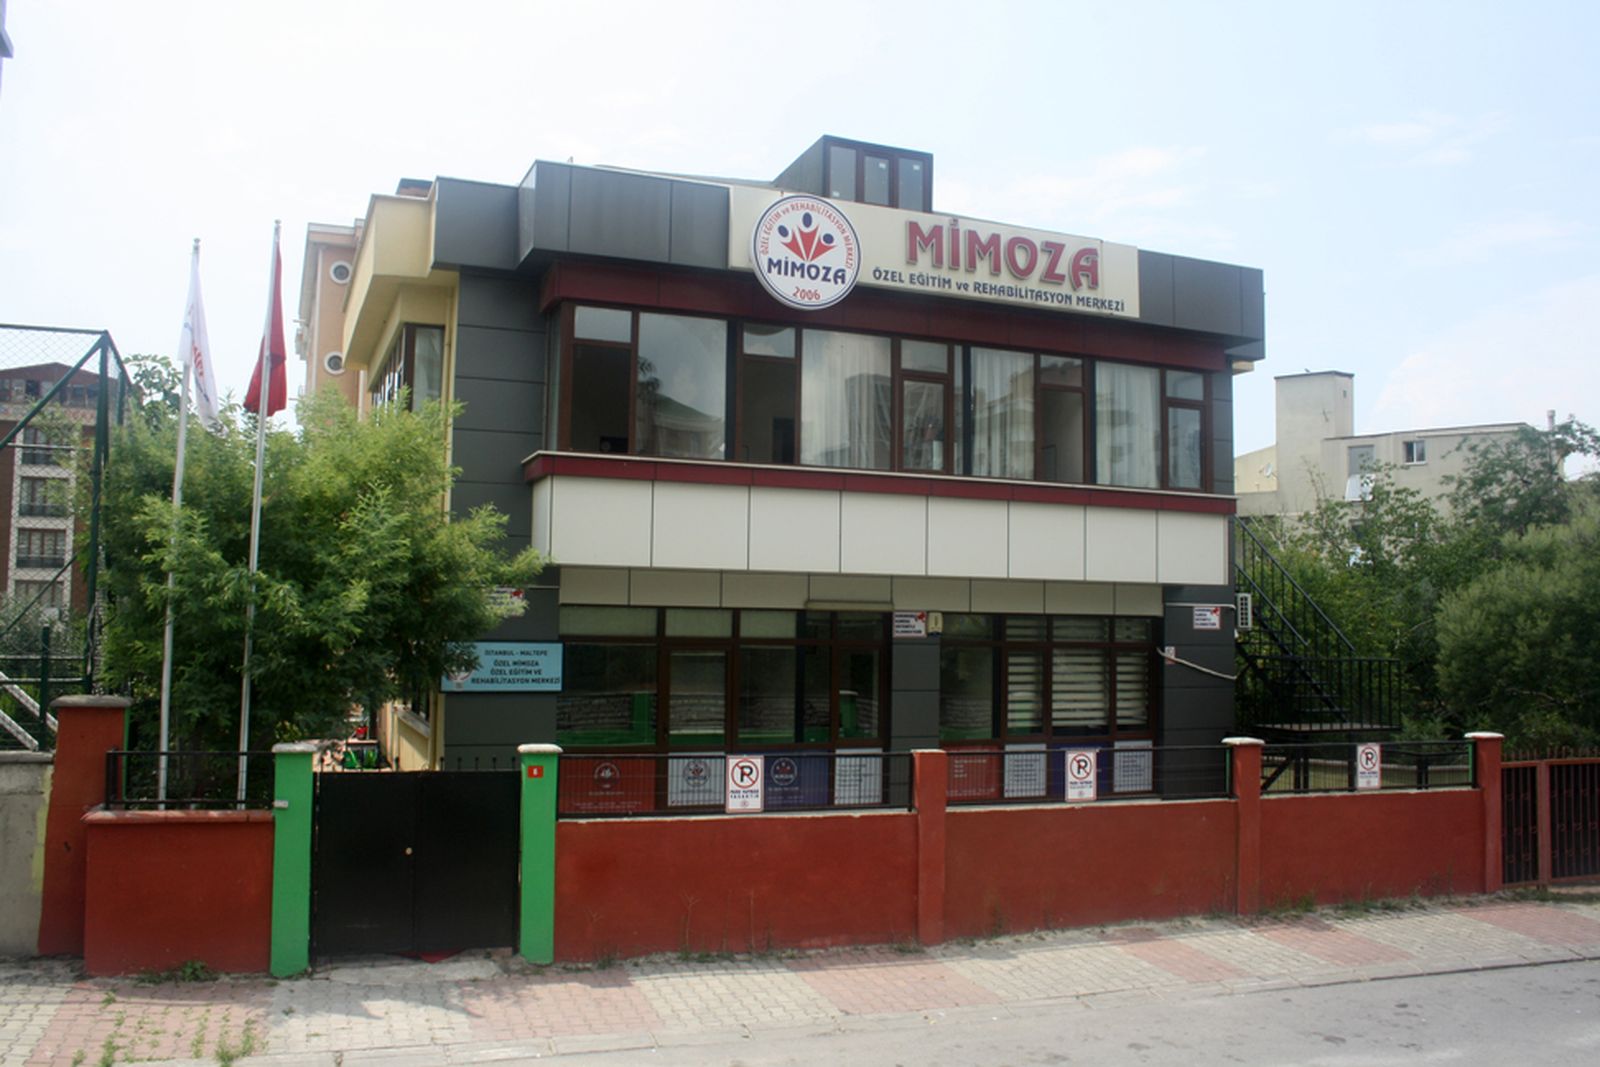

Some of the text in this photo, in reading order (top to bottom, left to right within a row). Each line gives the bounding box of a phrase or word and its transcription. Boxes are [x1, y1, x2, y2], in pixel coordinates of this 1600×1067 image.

[782, 207, 790, 215] ve
[906, 218, 1100, 291] MİMOZA
[767, 256, 847, 285] MİMOZA
[793, 286, 821, 300] 2006
[872, 266, 1125, 312] ÖZEL EĞİTİM ve REHABİLİTASYON MERKEZİ
[494, 659, 511, 667] ÖZEL
[490, 667, 507, 675] ÖZEL
[508, 667, 533, 675] EĞİTİM
[471, 676, 530, 684] REHABİLİTASYON
